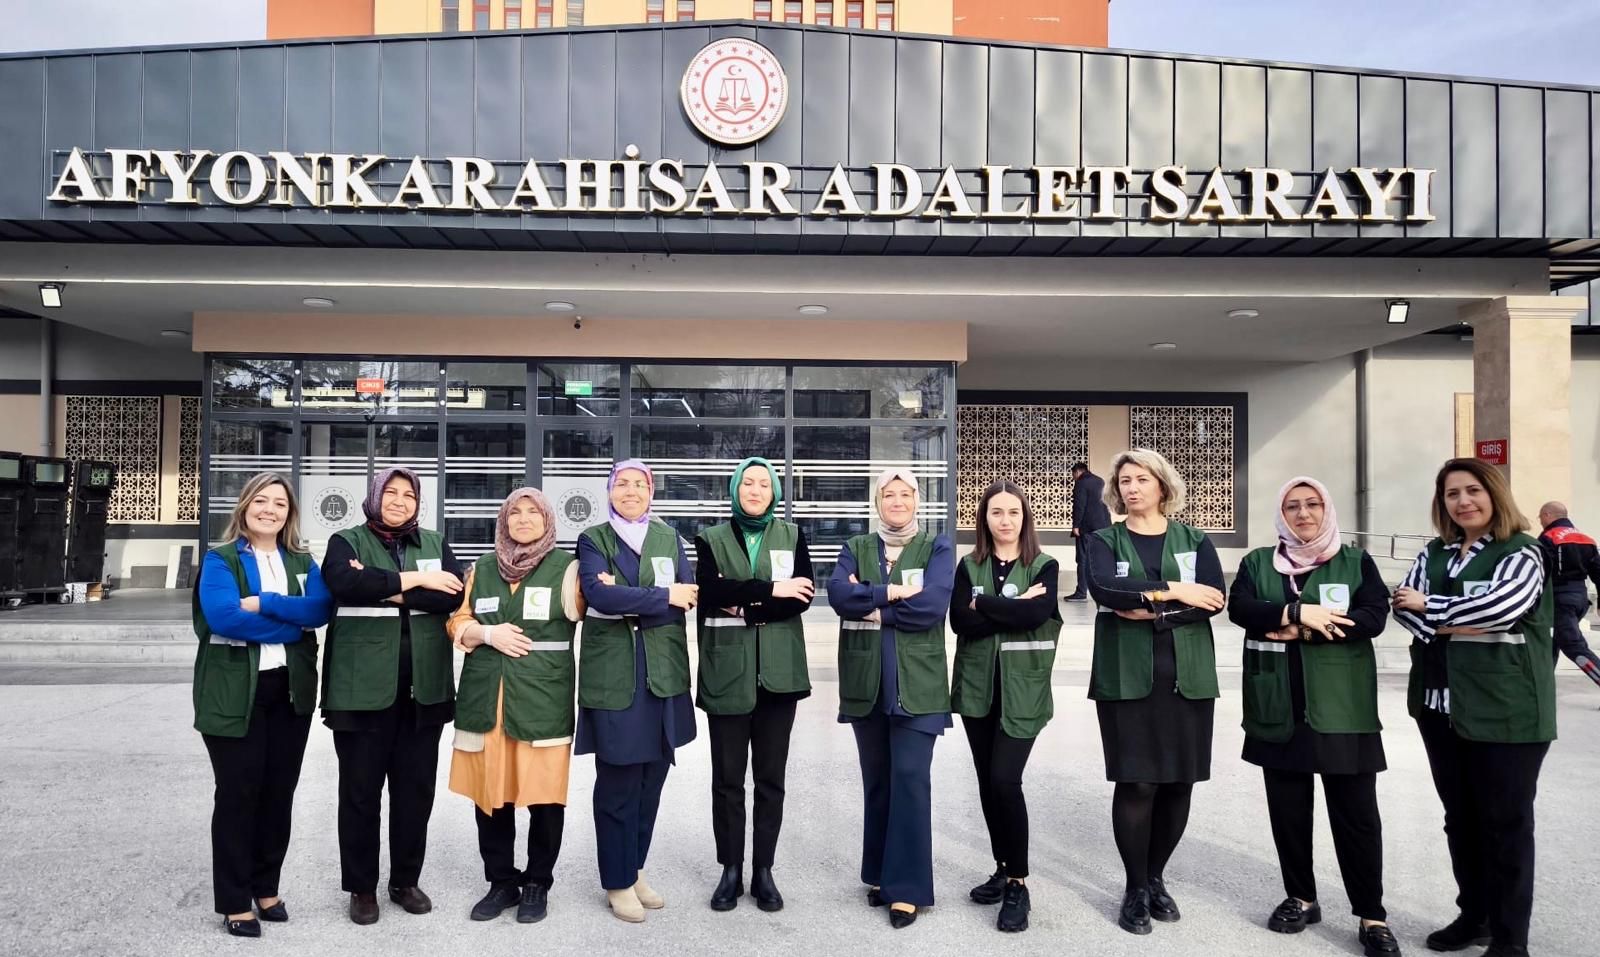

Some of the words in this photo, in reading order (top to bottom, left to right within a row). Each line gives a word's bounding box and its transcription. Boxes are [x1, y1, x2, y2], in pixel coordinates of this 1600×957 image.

[47, 144, 799, 215] AFYONKARAHİSAR
[811, 162, 1132, 219] ADALET
[1148, 164, 1437, 223] SARAYI
[1481, 441, 1502, 456] GİRİŞ
